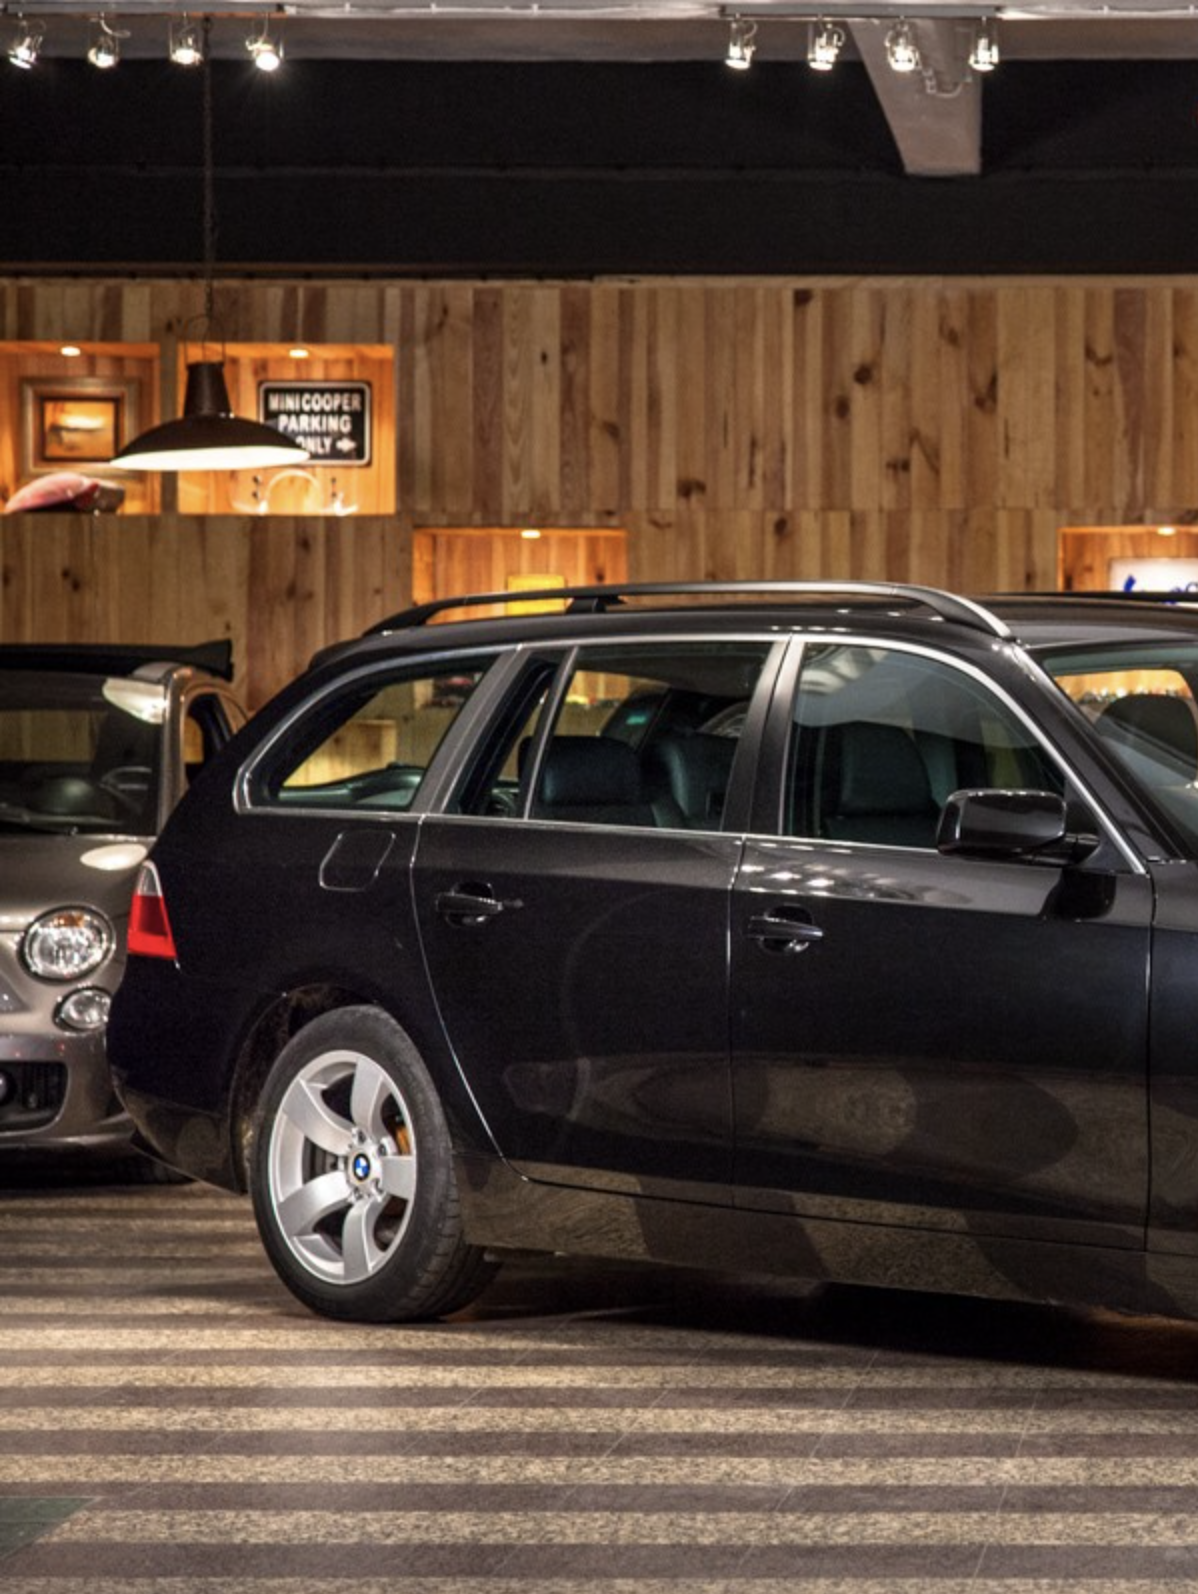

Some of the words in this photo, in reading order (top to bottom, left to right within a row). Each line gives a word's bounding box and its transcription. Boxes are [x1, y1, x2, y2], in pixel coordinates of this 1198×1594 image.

[268, 393, 299, 412] MINI
[302, 393, 361, 412] COOPER
[278, 414, 351, 433] PARKING
